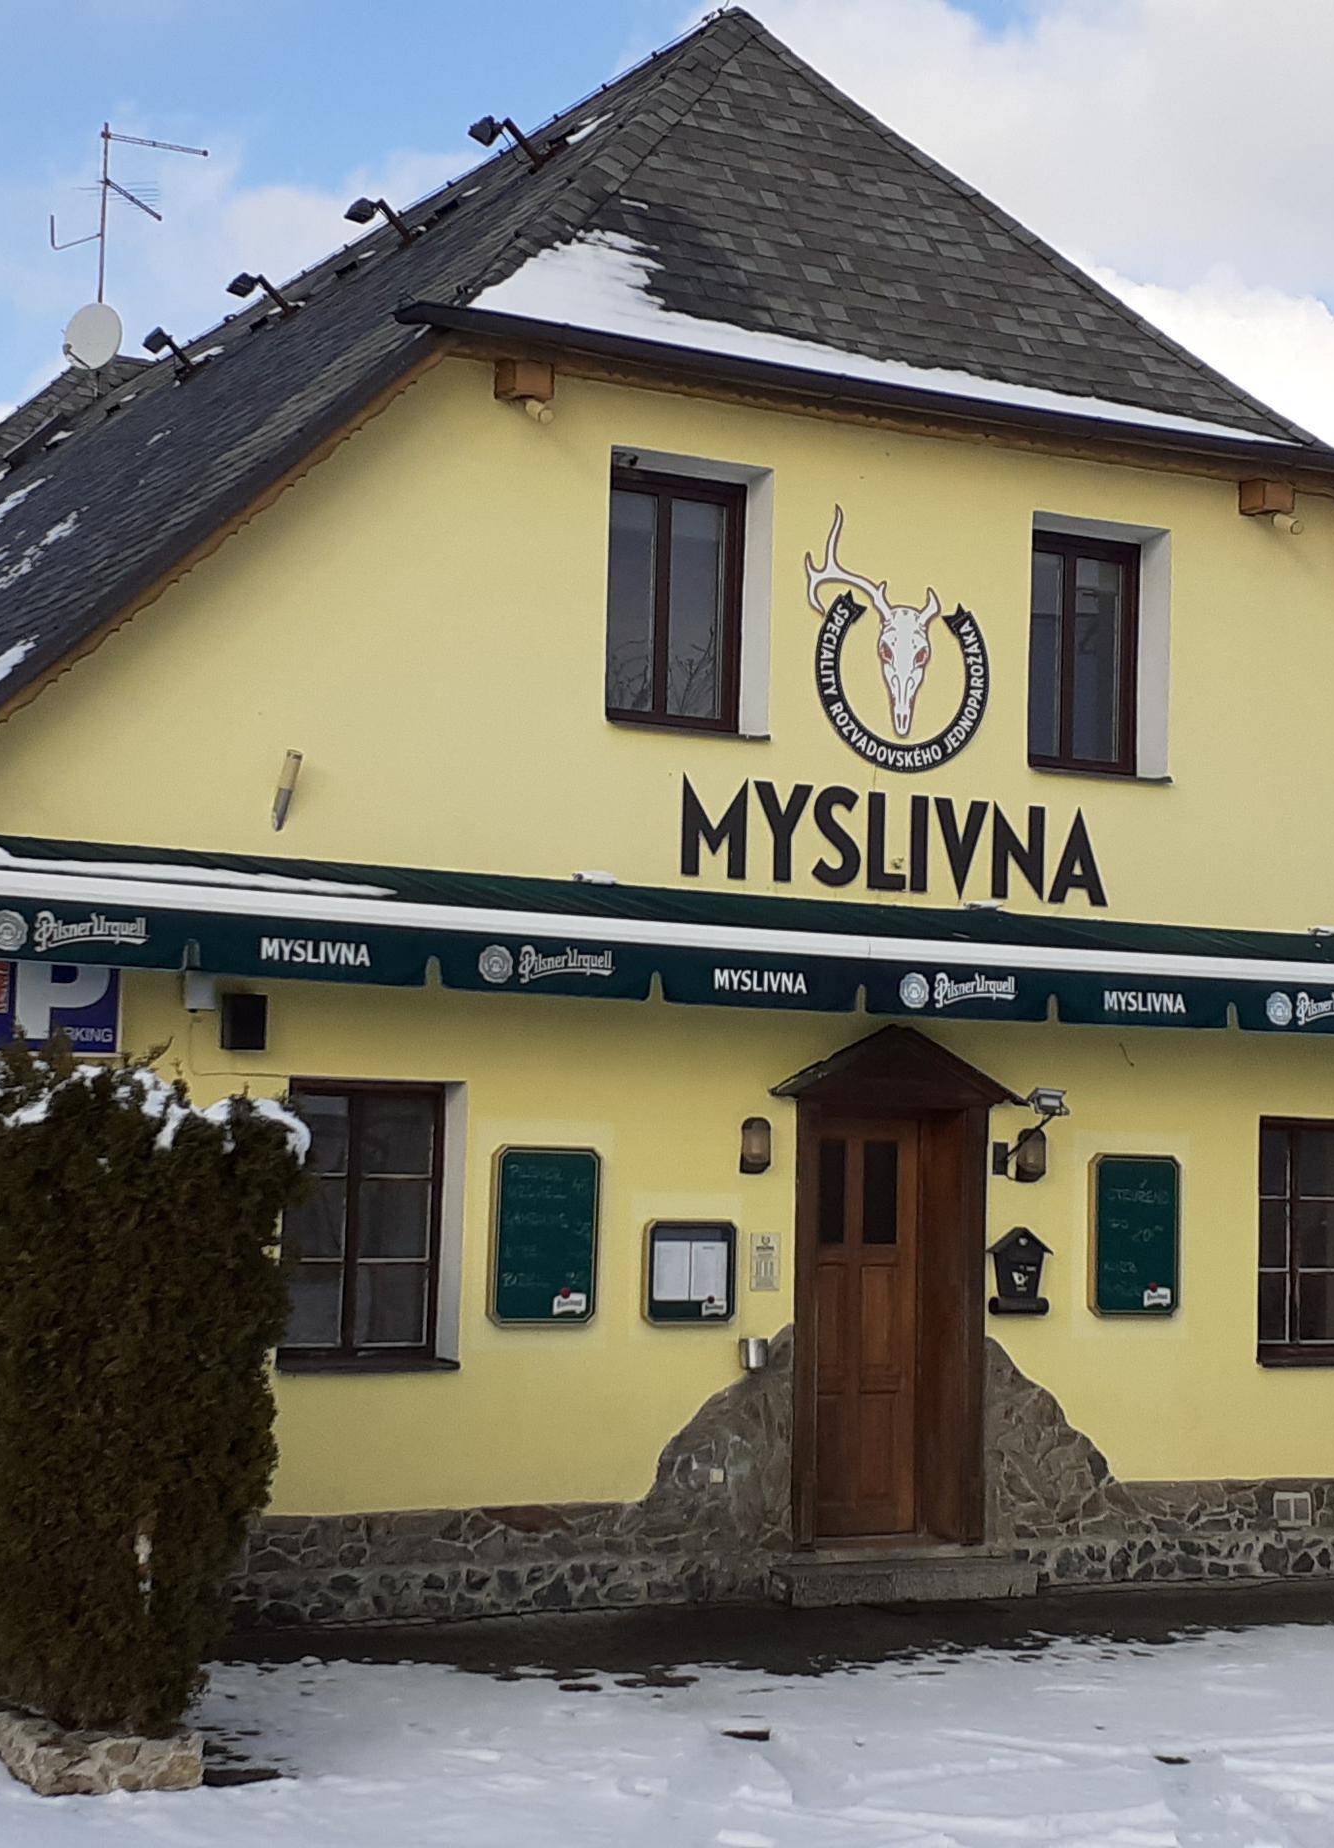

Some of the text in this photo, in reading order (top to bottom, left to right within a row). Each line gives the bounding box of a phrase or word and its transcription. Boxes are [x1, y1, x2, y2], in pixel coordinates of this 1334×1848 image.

[819, 604, 985, 768] SPECIALITY ROZVADOVSKÉHO JEDNOPAROŽÁKA
[680, 771, 1108, 907] MYSLIVNA
[33, 911, 149, 952] Pilsner Urquell
[260, 937, 371, 966] MYSLIVNA
[518, 945, 615, 984] Pilsner Urquell
[16, 960, 111, 1040] P
[713, 968, 808, 995] MYSLIVNA
[933, 972, 1017, 1008] Pilsner Urquell
[1103, 991, 1187, 1014] MYSLIVNA
[51, 1025, 114, 1043] RKING
